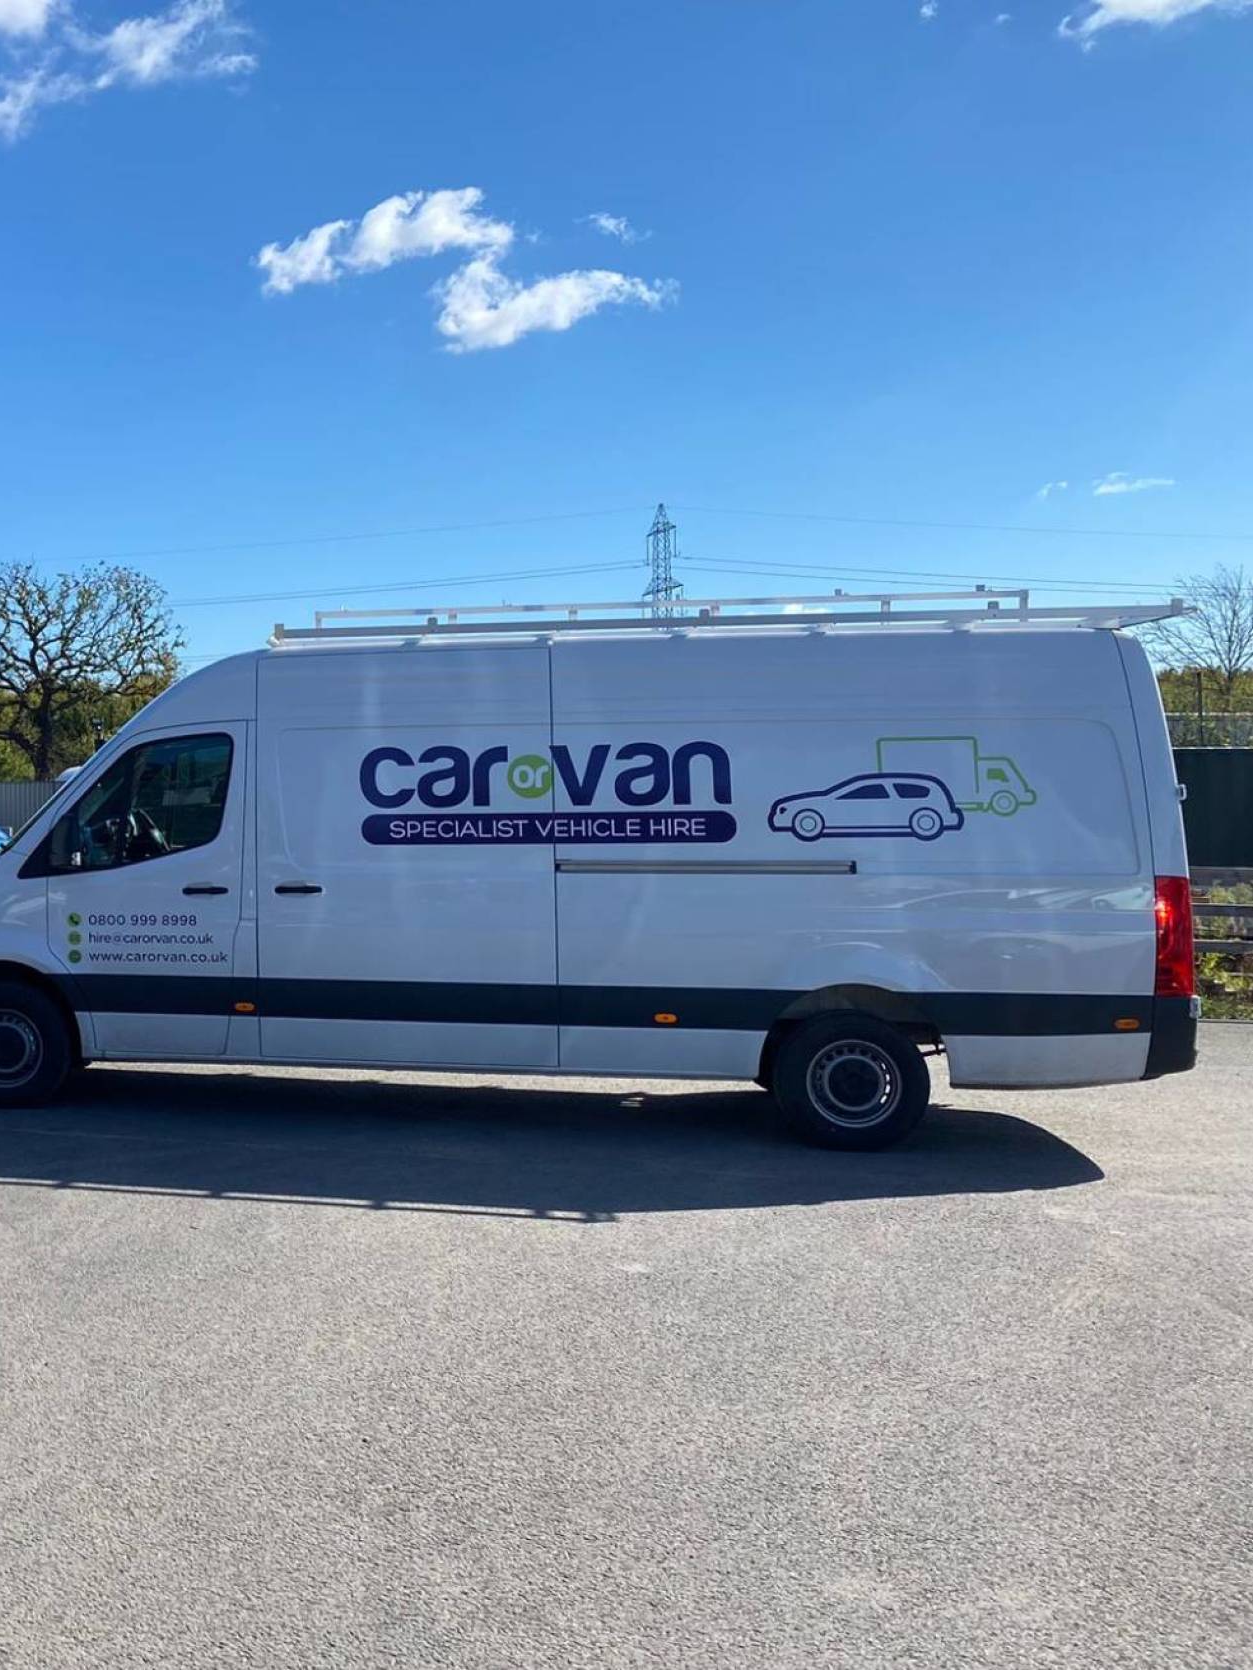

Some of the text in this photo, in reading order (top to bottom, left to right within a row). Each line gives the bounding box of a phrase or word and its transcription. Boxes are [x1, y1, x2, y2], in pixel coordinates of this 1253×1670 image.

[389, 818, 706, 839] SPECIALIST VEHICLE HIRE
[88, 914, 197, 926] 0800 999 8998
[88, 932, 214, 945] hire@carorvan.co.uk
[88, 952, 228, 963] www.carorvan.co.uk
